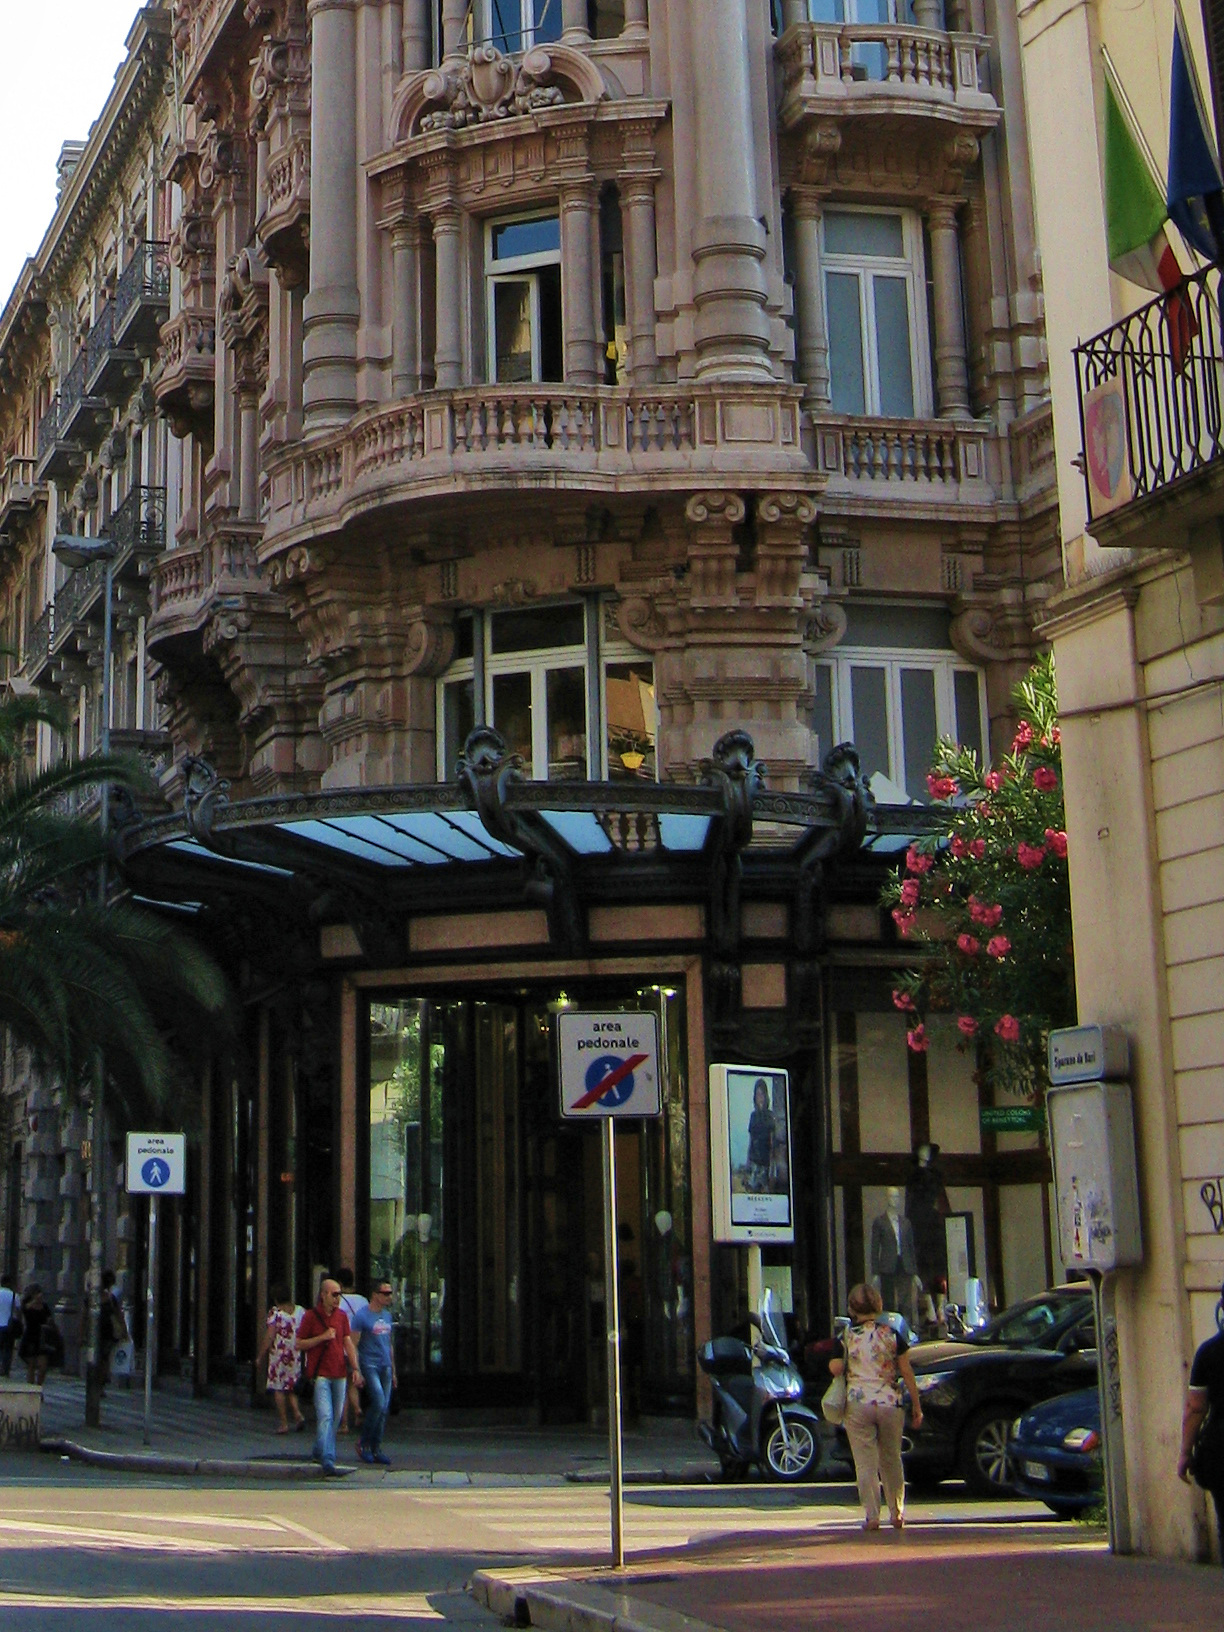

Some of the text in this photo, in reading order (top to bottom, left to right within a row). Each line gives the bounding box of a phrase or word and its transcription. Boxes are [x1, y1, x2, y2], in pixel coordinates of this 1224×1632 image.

[593, 1022, 622, 1032] area
[577, 1037, 640, 1050] pedonale
[137, 1147, 175, 1155] pedonale
